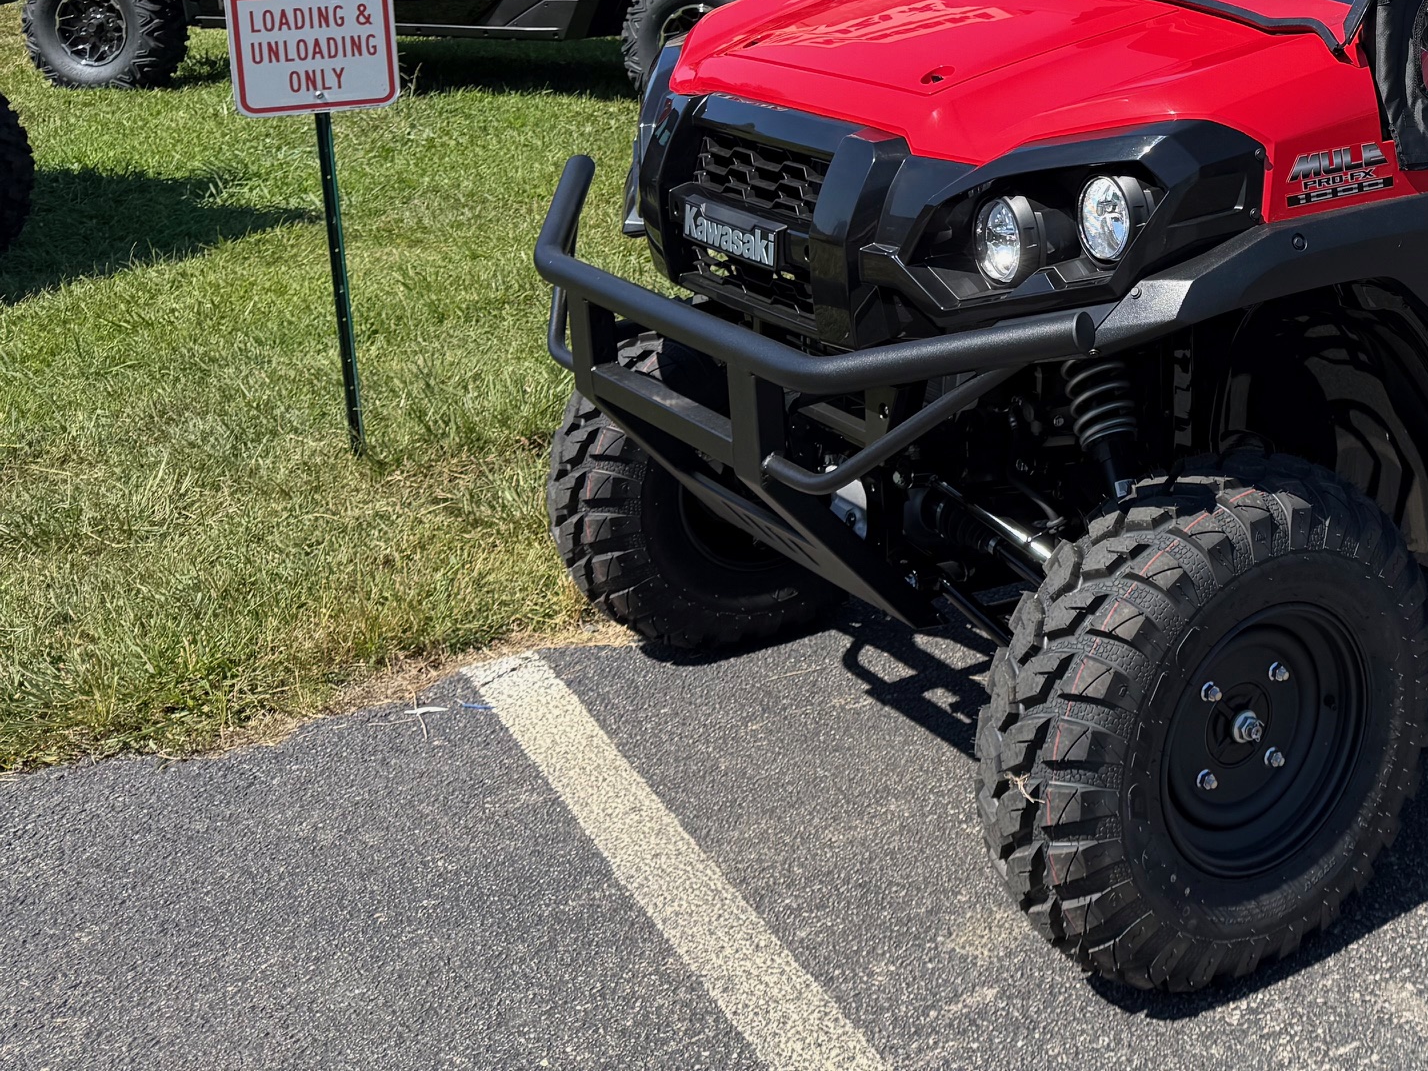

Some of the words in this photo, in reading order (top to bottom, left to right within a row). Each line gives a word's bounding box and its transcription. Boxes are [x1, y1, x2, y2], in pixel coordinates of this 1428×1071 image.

[249, 5, 345, 33] LOADING
[355, 3, 373, 26] &
[250, 34, 378, 65] UNLOADING
[289, 67, 345, 93] ONLY
[1287, 142, 1389, 183] MULE
[1297, 179, 1384, 203] 1000
[1302, 167, 1377, 192] PRO-FX
[684, 203, 776, 267] Kawasaki
